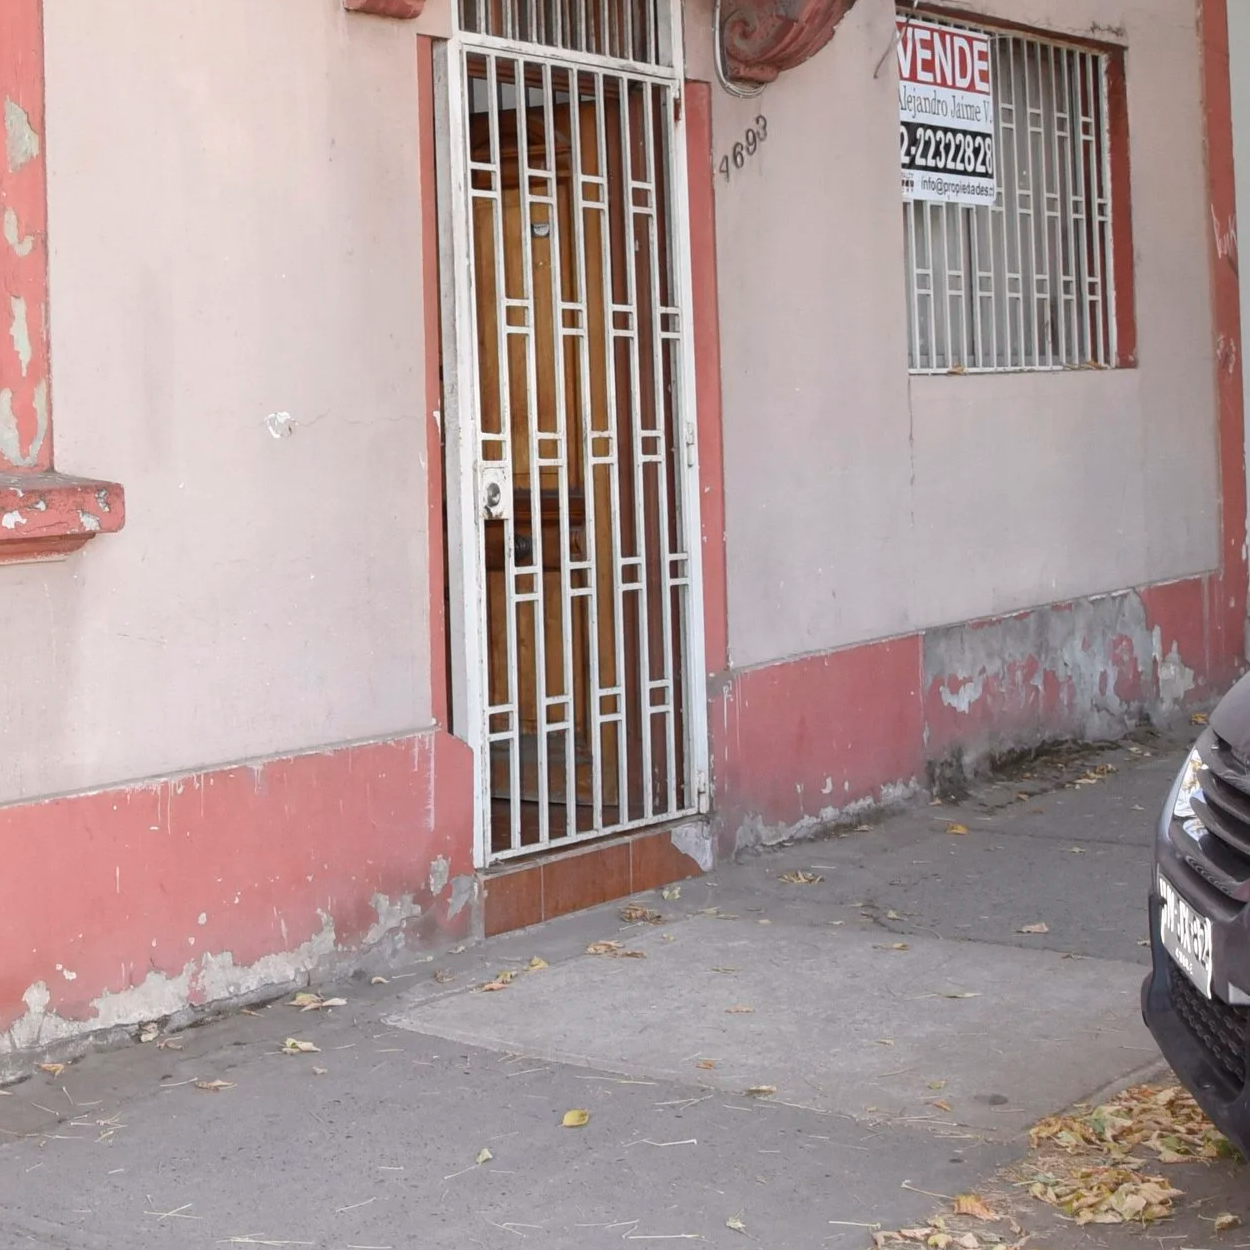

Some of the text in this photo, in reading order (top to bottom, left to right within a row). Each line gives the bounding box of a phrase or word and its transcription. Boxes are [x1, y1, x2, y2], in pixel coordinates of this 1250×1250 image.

[896, 26, 989, 92] VENDE
[951, 95, 981, 122] Jaime
[719, 115, 767, 183] 4693
